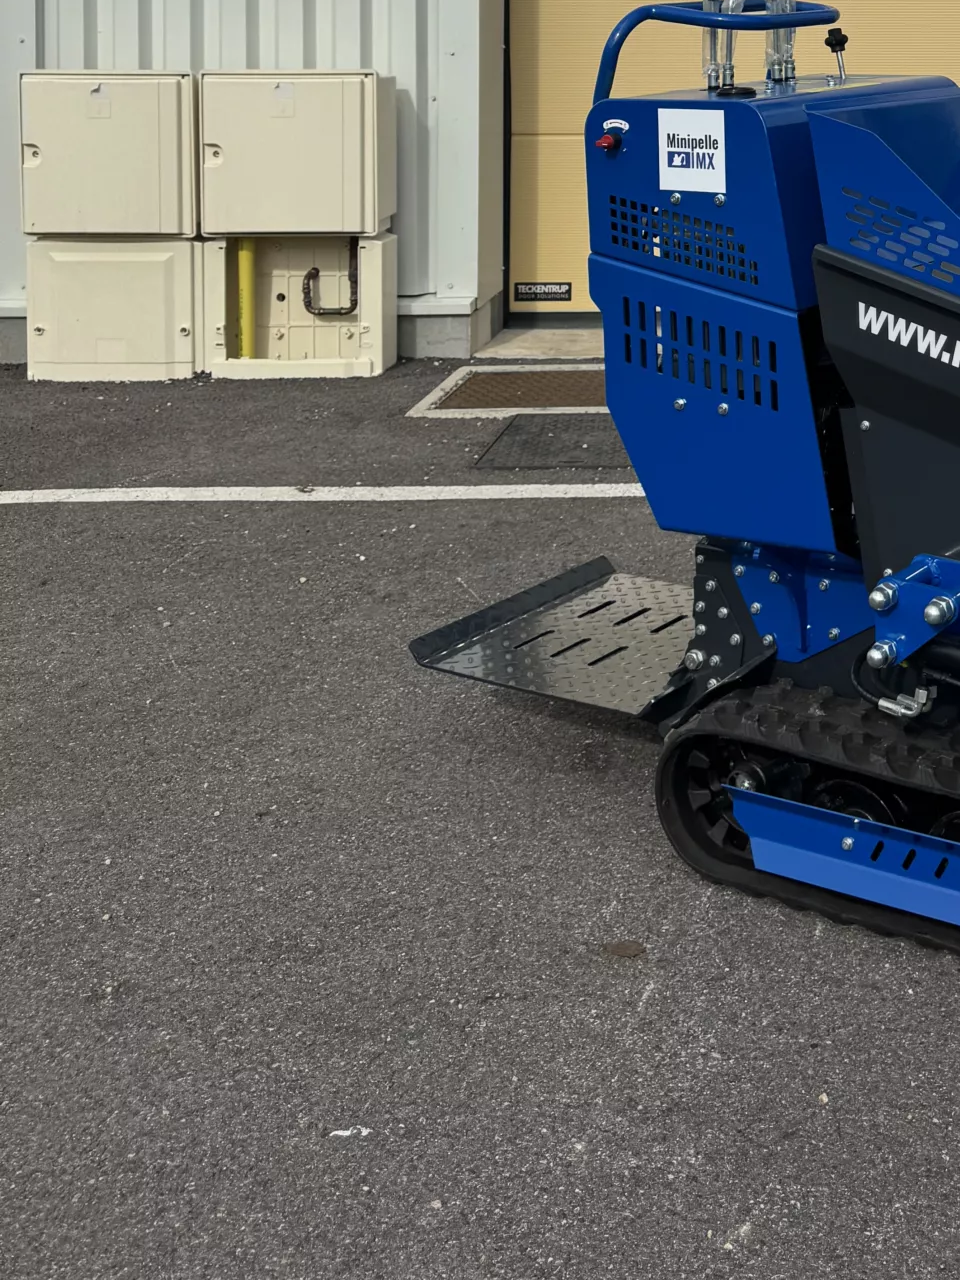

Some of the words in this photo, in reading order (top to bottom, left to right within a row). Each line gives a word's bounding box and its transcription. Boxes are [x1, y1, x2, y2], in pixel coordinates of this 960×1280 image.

[666, 133, 719, 151] Minipelle
[691, 152, 716, 170] IMX
[517, 284, 569, 293] TECKENTRUP
